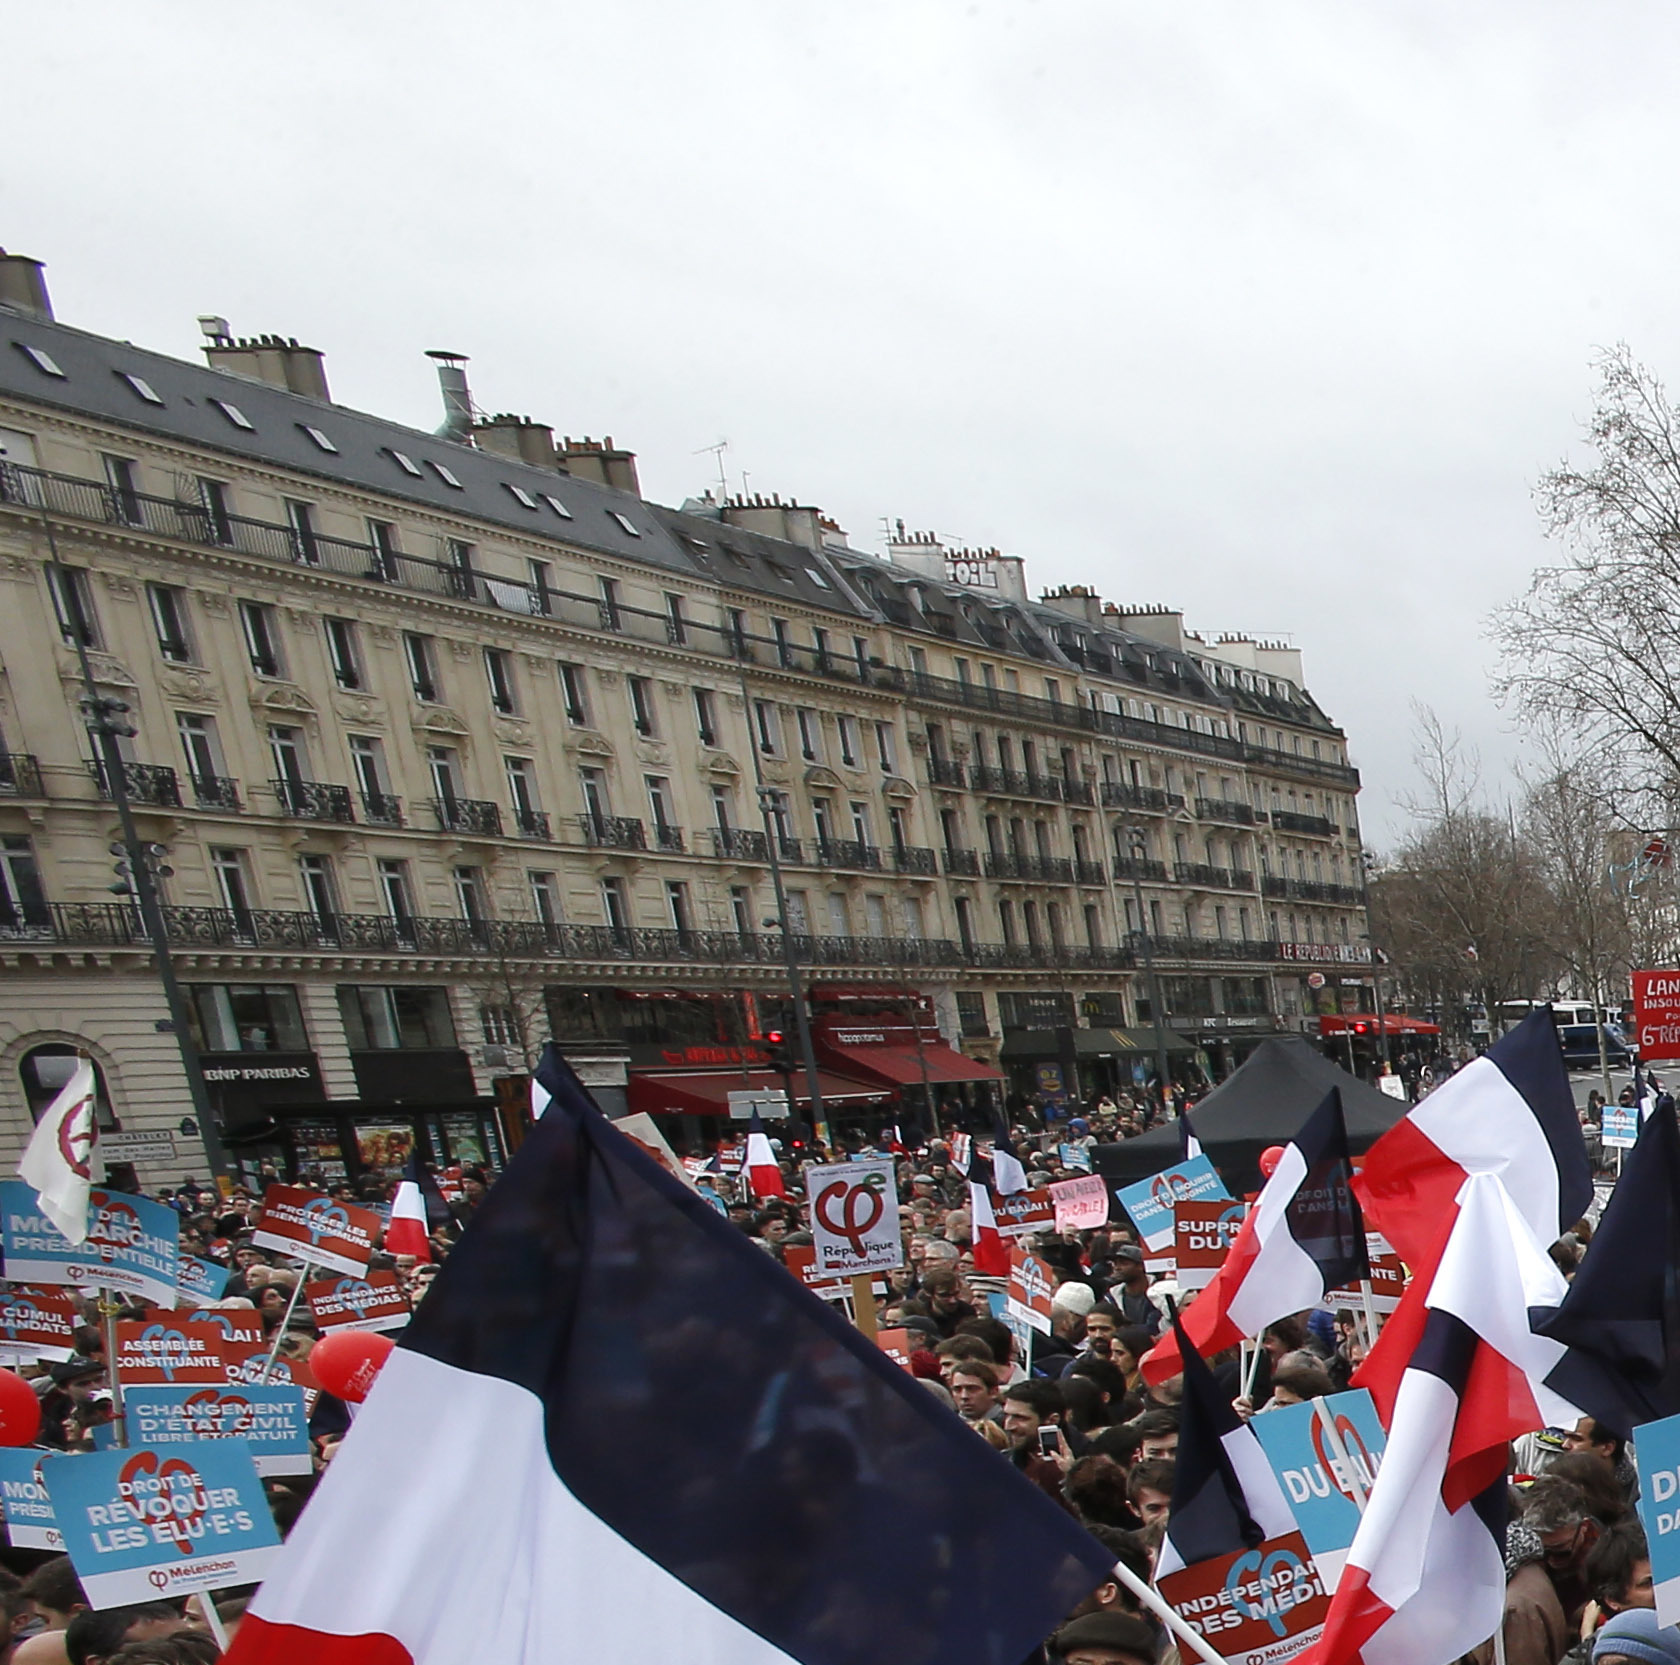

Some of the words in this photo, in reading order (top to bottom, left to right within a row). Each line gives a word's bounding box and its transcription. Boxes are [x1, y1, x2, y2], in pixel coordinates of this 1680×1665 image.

[1282, 943, 1293, 960] LE
[204, 1069, 240, 1081] BNP
[242, 1067, 310, 1079] PARIBAS
[1130, 1194, 1161, 1212] DROIT
[1176, 1172, 1213, 1194] MOURIR
[1008, 1203, 1041, 1214] BALAI
[308, 1219, 371, 1249] COMMUNS
[1189, 1236, 1222, 1249] DU
[12, 1236, 174, 1277] PRÉSIDENTIELLE
[316, 1301, 344, 1316] DES
[346, 1293, 401, 1311] MÉDIAS
[3, 1306, 66, 1324] CUMUL
[123, 1337, 205, 1352] ASSEMBLÉE
[116, 1356, 220, 1368] CONSTITUANTE
[135, 1402, 297, 1416] CHANGEMENT
[140, 1417, 226, 1431] D'ÉTAT
[241, 1415, 296, 1430] CIVIL
[142, 1430, 194, 1443] LIBRE
[117, 1476, 177, 1496] DROIT
[180, 1472, 202, 1487] DE
[1282, 1463, 1331, 1504] DU
[86, 1487, 242, 1527] RÉVOQUER
[88, 1525, 149, 1553] LES
[169, 1560, 236, 1578] Mélenchon
[1250, 1578, 1324, 1622] MÉDI
